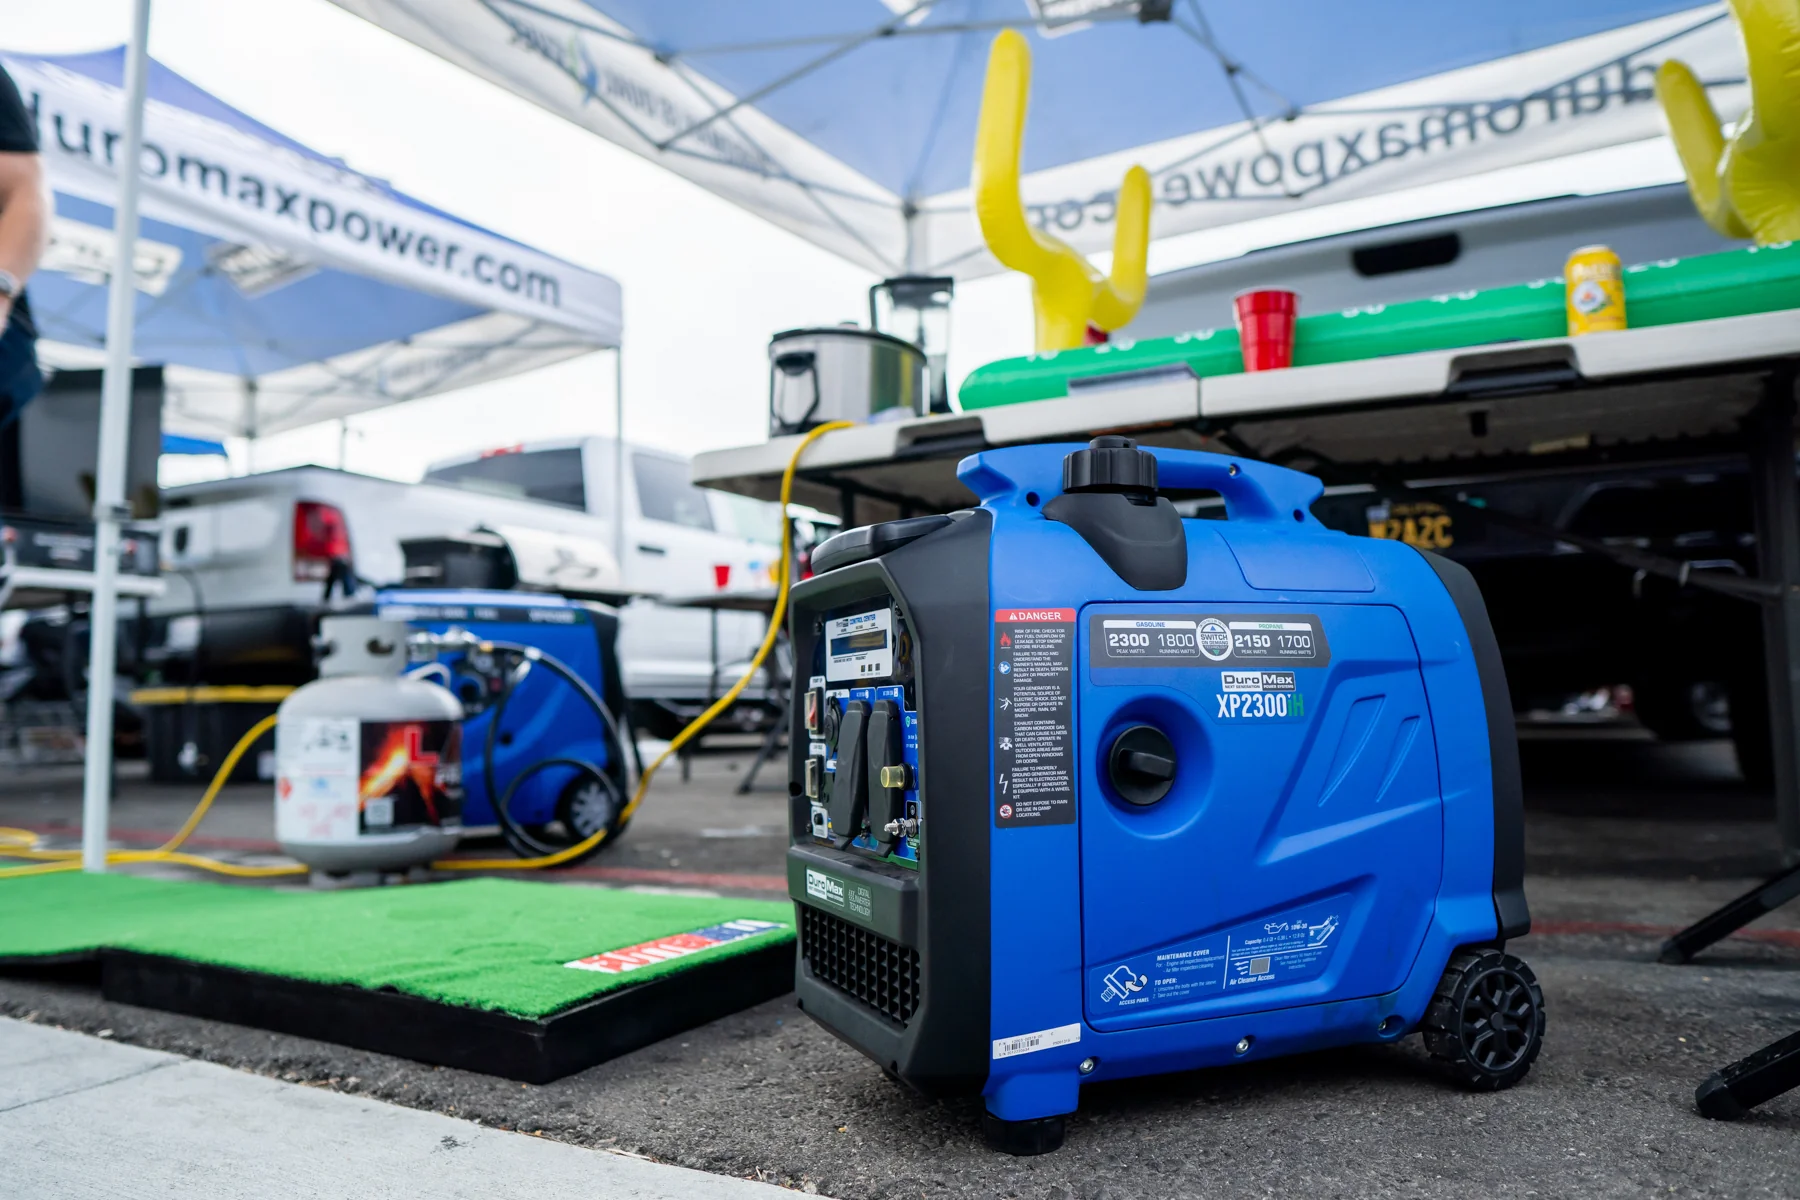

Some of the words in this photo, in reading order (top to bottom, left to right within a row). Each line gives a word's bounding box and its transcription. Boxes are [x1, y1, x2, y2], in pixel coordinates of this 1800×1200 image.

[1109, 634, 1149, 646] 2300
[1158, 634, 1194, 646] 1800
[1235, 635, 1271, 647] 2150
[1278, 636, 1310, 648] 1700
[1216, 693, 1304, 718] XP2300iH
[857, 887, 871, 898] DIGITAL
[1157, 952, 1192, 961] MAINTENANCE
[1238, 976, 1257, 984] Cleaner
